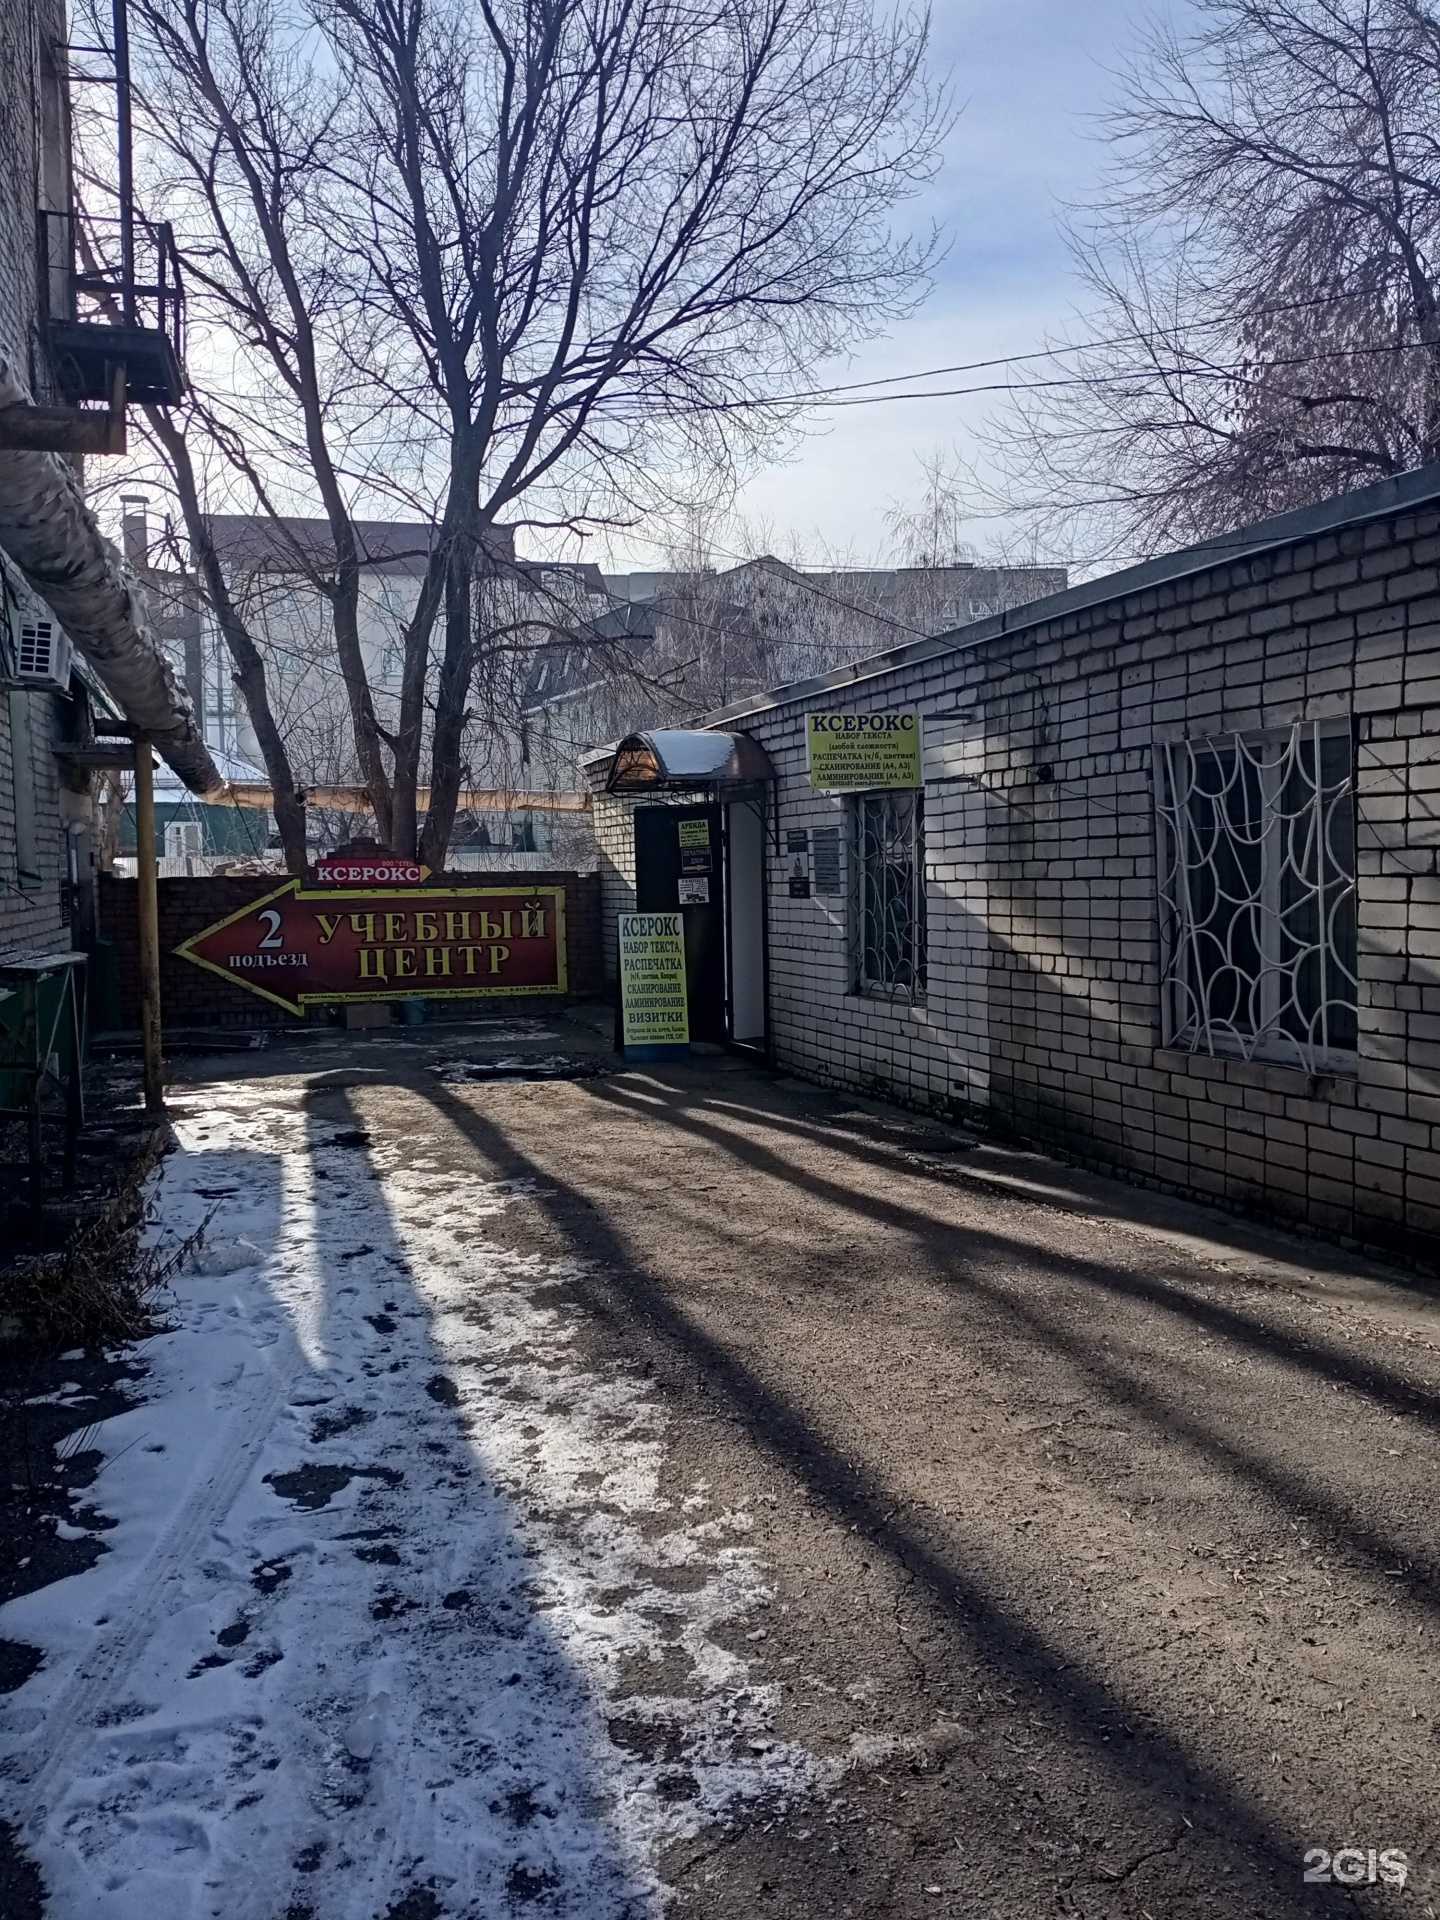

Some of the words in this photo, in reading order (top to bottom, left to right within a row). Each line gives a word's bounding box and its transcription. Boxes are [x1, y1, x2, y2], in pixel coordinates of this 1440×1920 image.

[811, 715, 914, 732] КСЕРОКС
[835, 732, 860, 740] НАБОР
[863, 731, 893, 739] ТЕКСТА
[829, 743, 856, 751] (любой
[813, 753, 862, 761] РАСПЕЧАТКА
[817, 772, 885, 781] ЛАМИНИРОВАНИЕ
[317, 866, 421, 882] КСЕРОКС
[256, 910, 284, 949] 2
[312, 902, 548, 945] УЧЕБНЫЙ
[622, 916, 680, 937] КСЕРОКС
[623, 941, 649, 954] НАБОР
[651, 941, 682, 955] ТЕКСТА,
[229, 951, 308, 969] подъезд
[357, 945, 511, 983] ЦЕНТР
[624, 959, 683, 971] РАСПЕЧАТКА
[627, 983, 682, 994] СКАНИРОВАНИЕ
[625, 997, 685, 1009] ЛАМИНИРОВАНИЕ
[628, 1011, 683, 1024] ВИЗИТКИ
